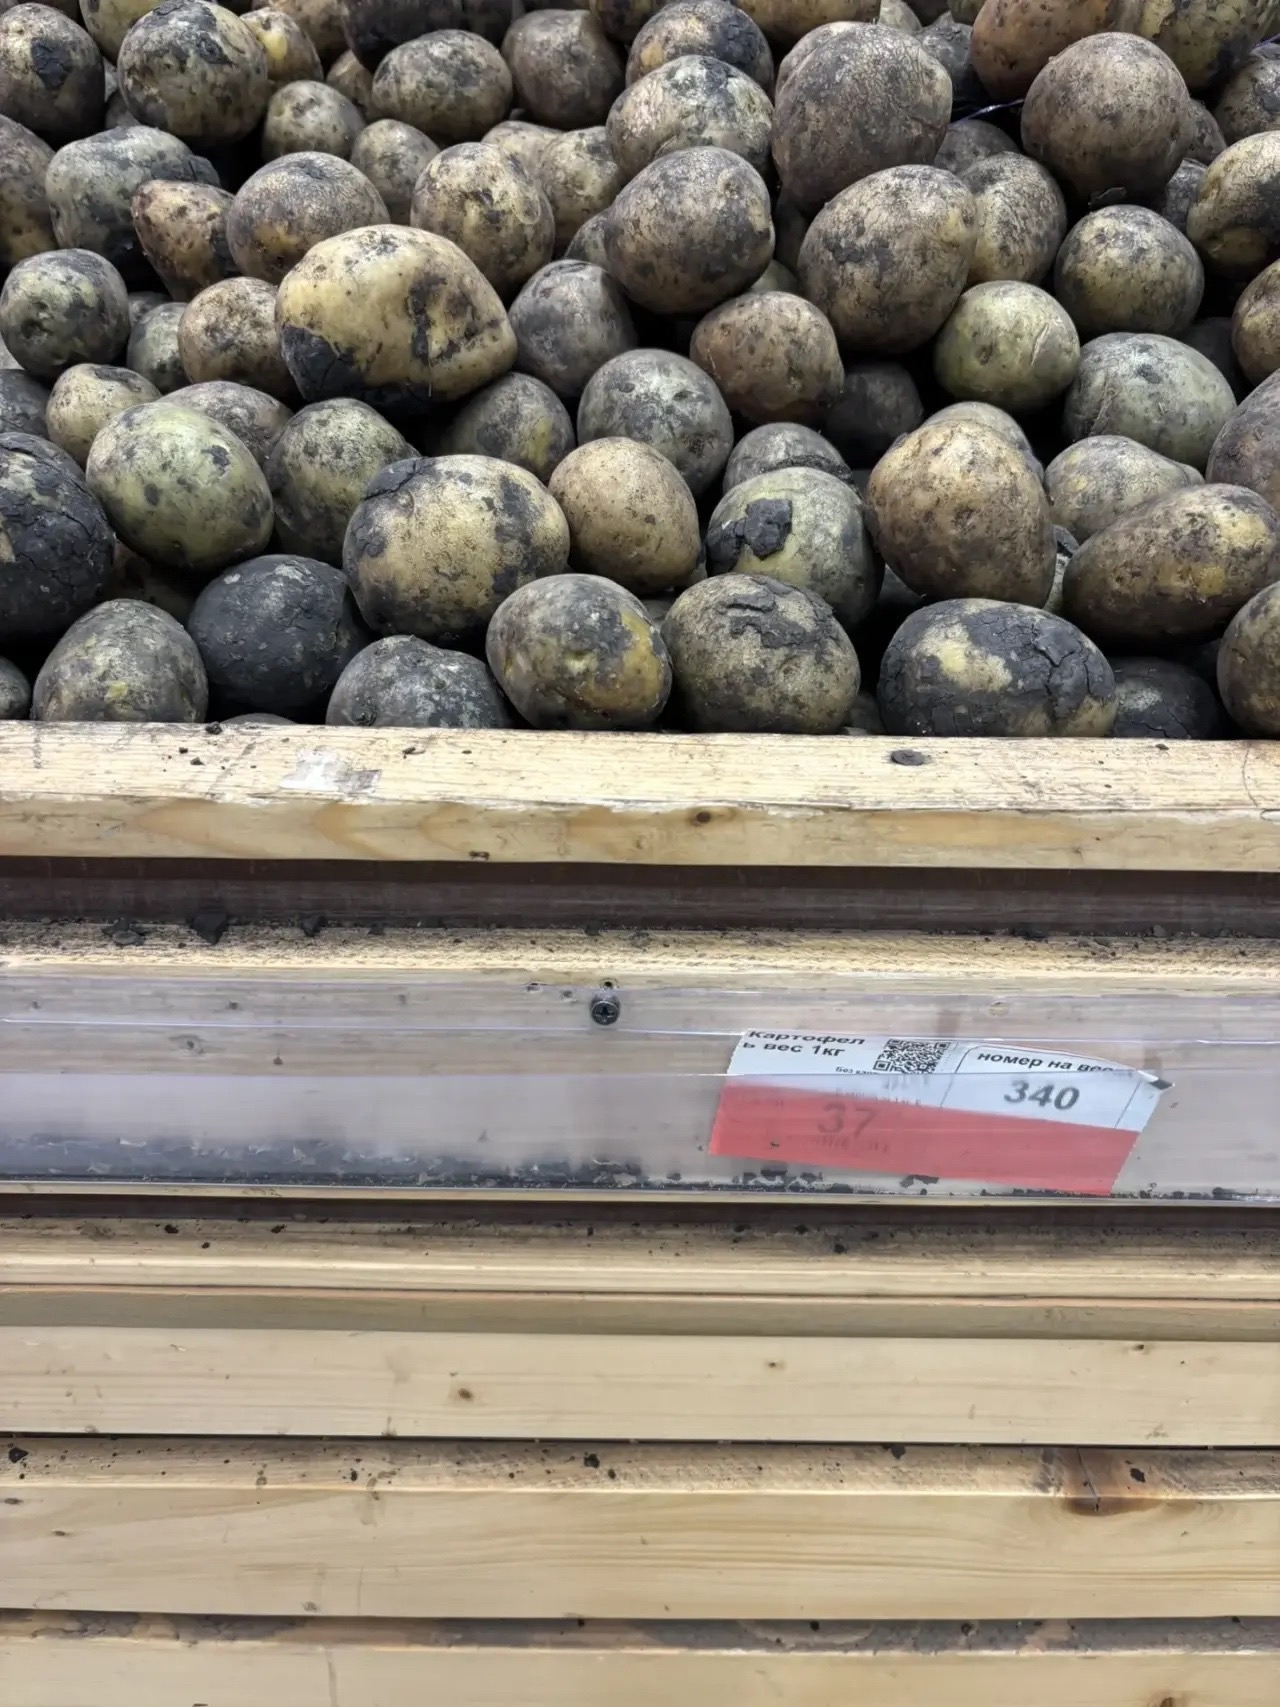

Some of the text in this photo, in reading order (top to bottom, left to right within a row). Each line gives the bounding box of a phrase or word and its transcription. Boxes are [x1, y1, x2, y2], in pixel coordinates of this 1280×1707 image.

[749, 1031, 865, 1045] Картофел
[763, 1043, 803, 1053] вес
[813, 1045, 845, 1056] 1кг
[977, 1052, 1043, 1068] номер
[1047, 1060, 1072, 1070] на
[1003, 1079, 1080, 1110] 340
[817, 1102, 878, 1138] 37
